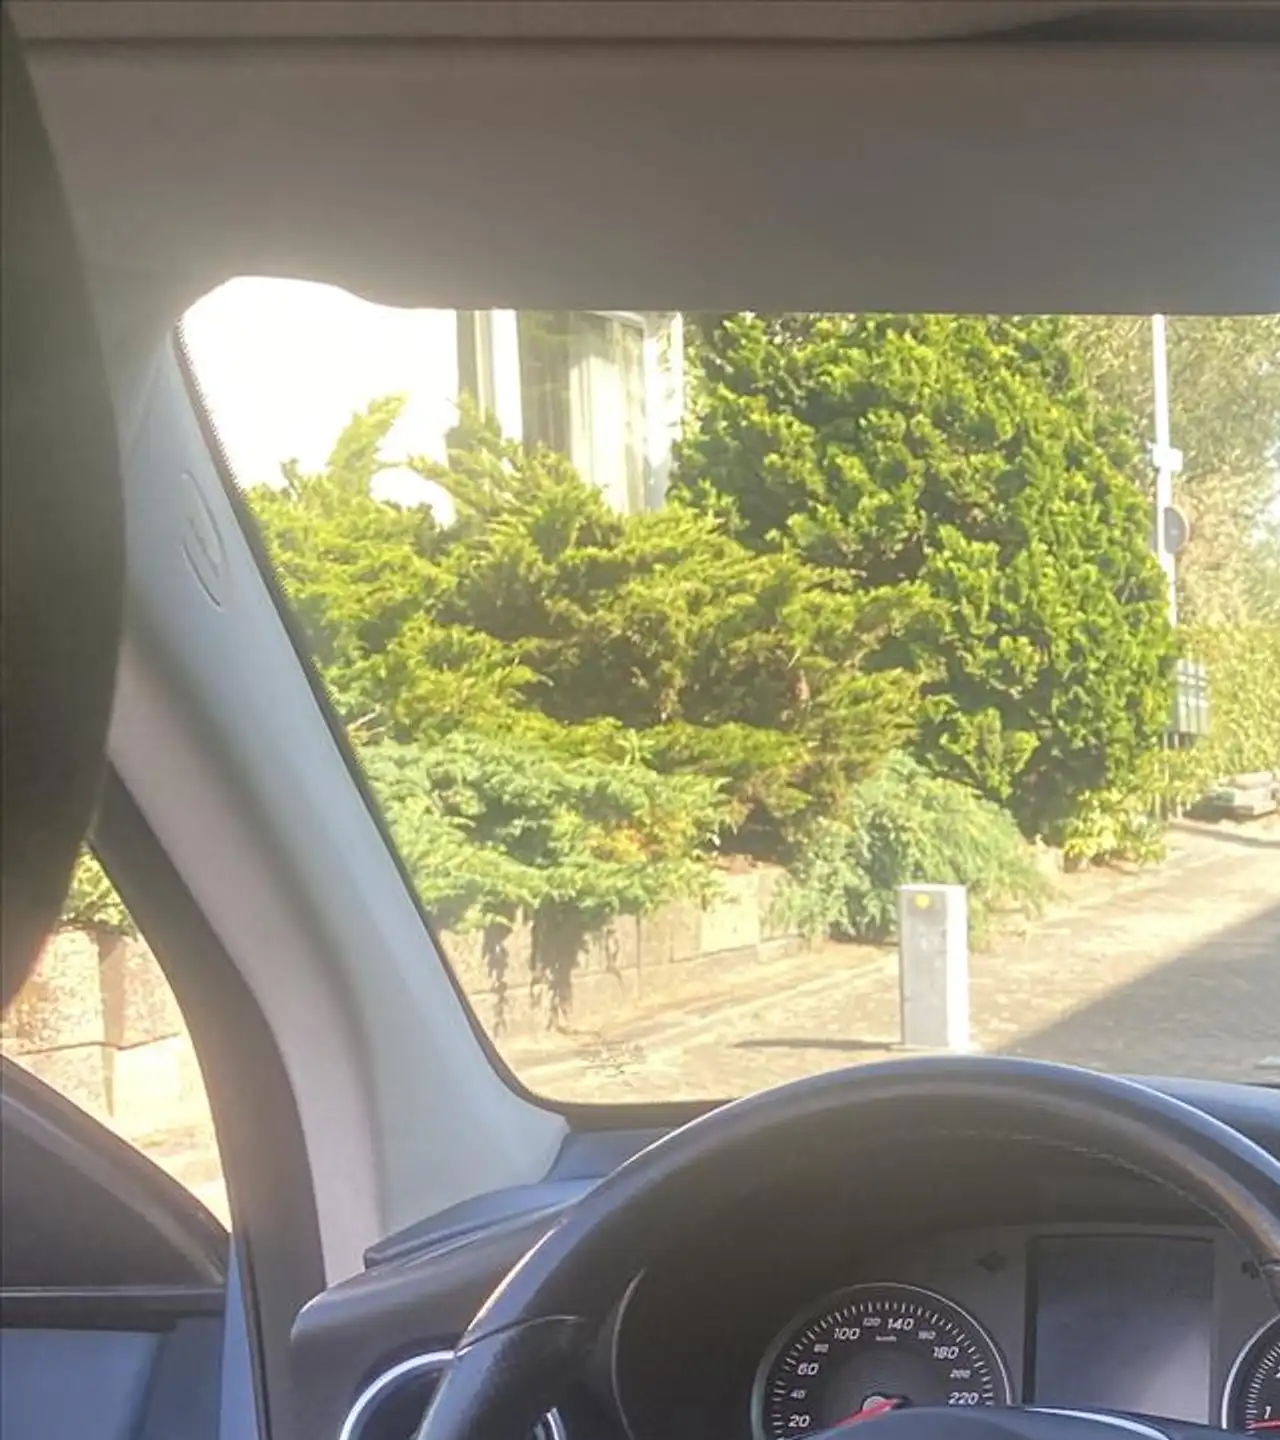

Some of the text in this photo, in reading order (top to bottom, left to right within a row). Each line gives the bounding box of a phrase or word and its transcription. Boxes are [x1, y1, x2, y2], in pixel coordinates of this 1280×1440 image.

[887, 1317, 914, 1331] 140
[833, 1327, 860, 1340] 100
[932, 1346, 959, 1359] 180
[797, 1362, 819, 1375] 60
[948, 1392, 979, 1405] 220
[1264, 1406, 1272, 1419] 1
[788, 1415, 810, 1428] 20
